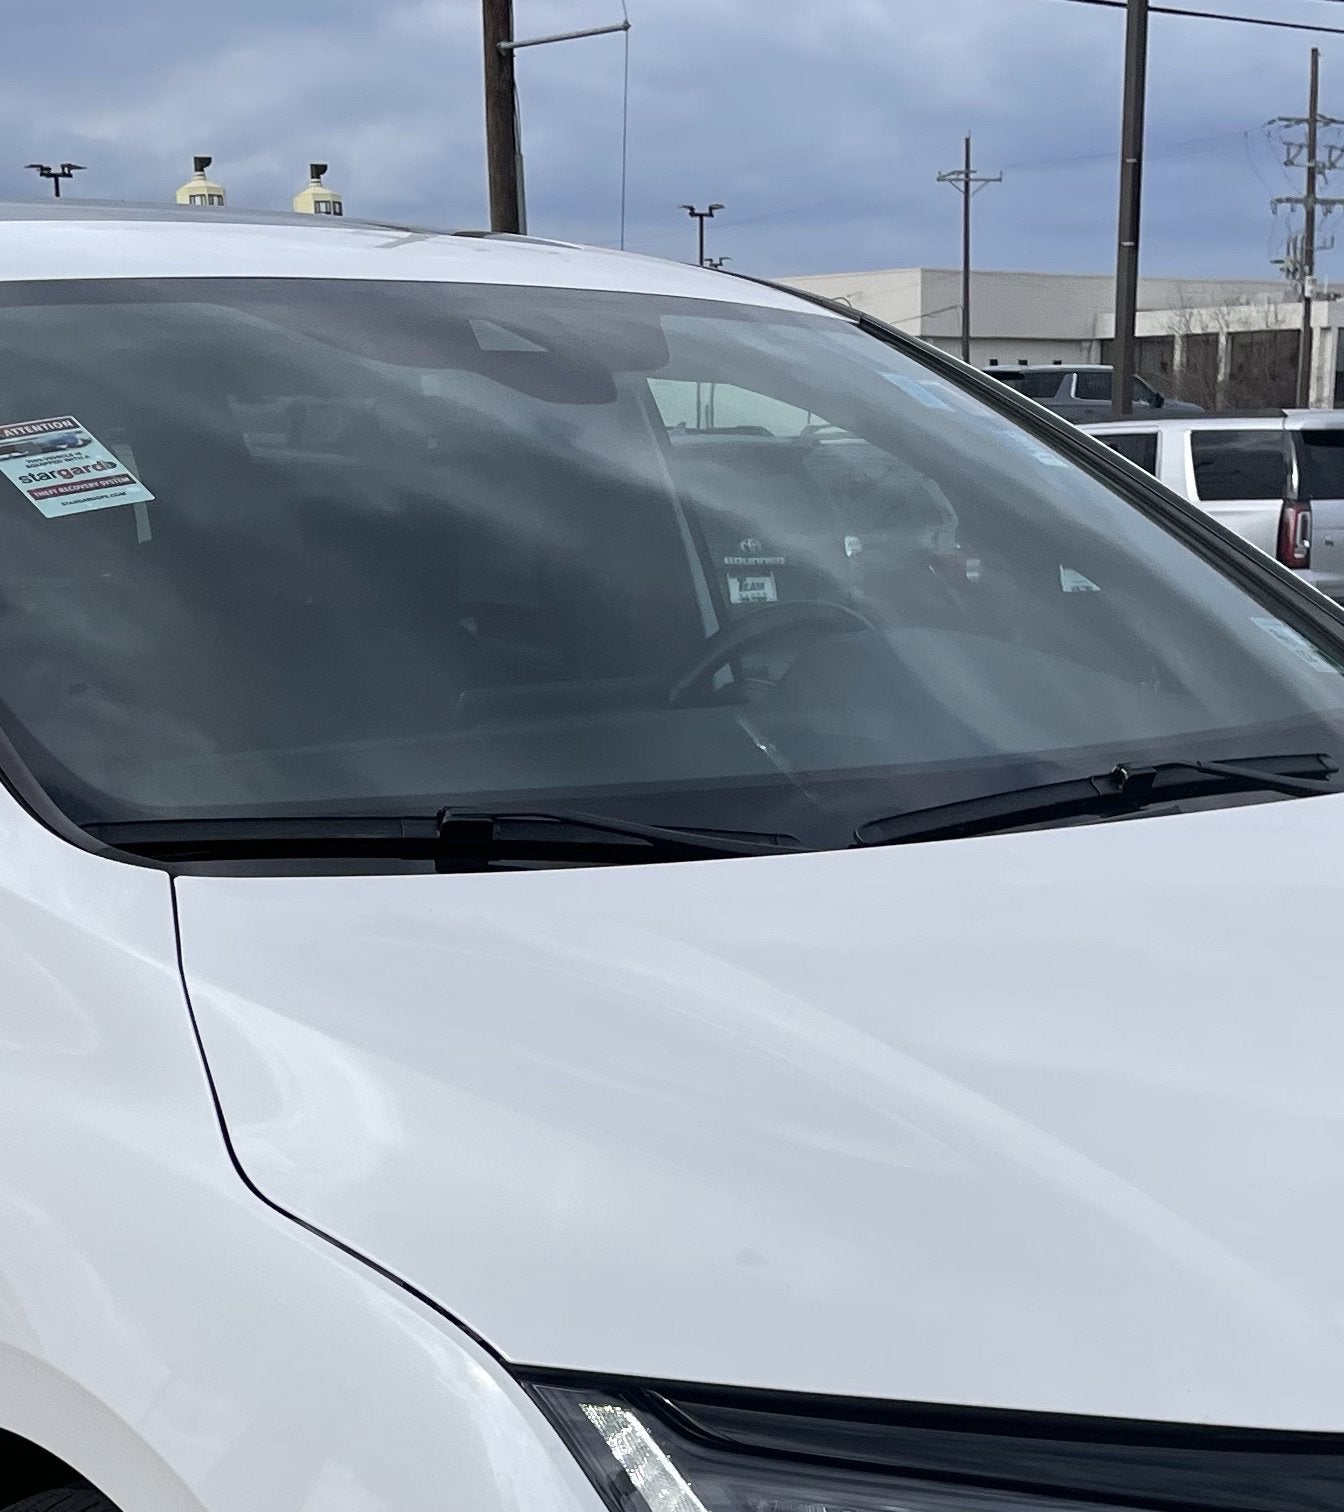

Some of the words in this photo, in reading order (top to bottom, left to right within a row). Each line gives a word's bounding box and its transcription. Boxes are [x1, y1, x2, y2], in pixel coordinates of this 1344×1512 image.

[3, 419, 74, 438] ATTENTION
[33, 488, 58, 498] THEFT
[58, 481, 100, 494] RECOVERY
[99, 477, 130, 487] SYSTEM
